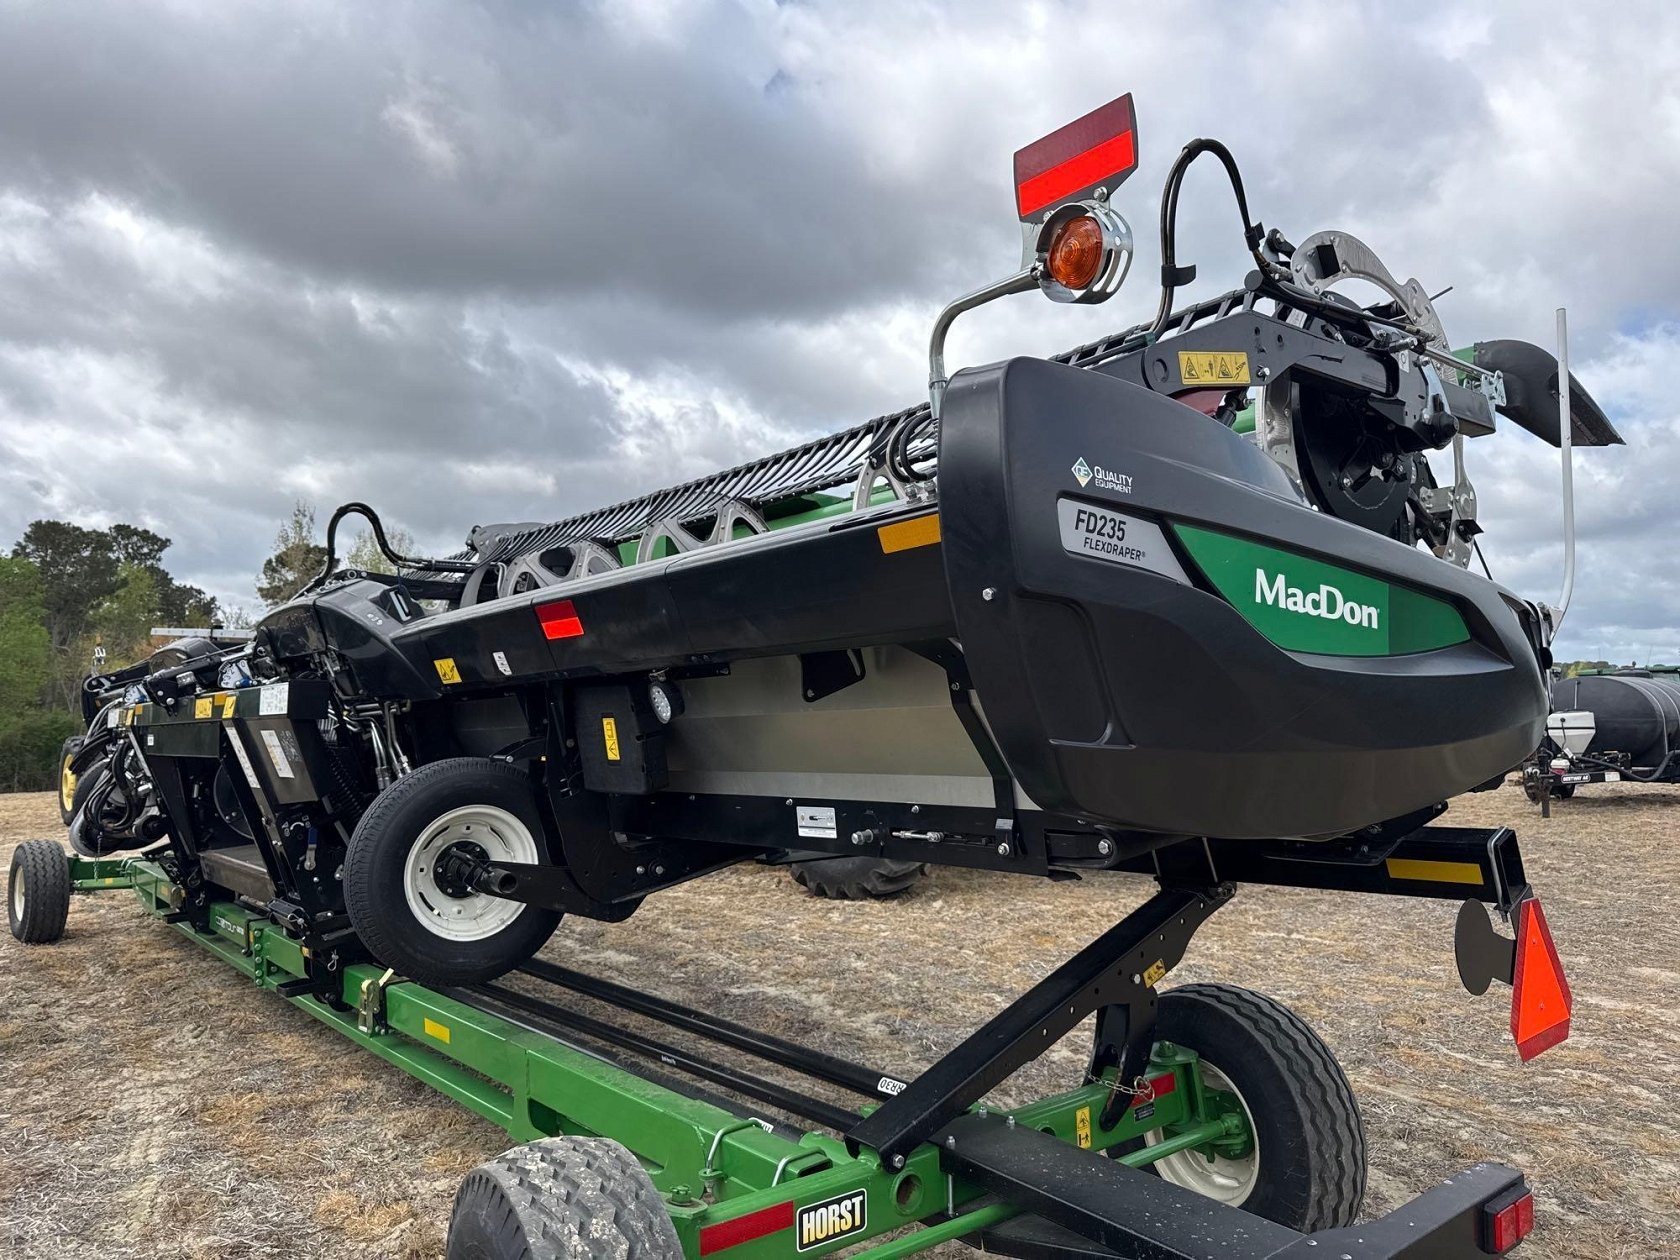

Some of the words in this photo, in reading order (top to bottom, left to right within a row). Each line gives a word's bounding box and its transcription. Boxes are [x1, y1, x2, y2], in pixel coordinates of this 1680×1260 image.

[1094, 466, 1133, 486] QUALITY
[1095, 478, 1132, 494] EQUIPMENT
[1075, 508, 1127, 542] FD235
[1255, 567, 1379, 630] MacDon
[802, 1194, 864, 1245] HORST
